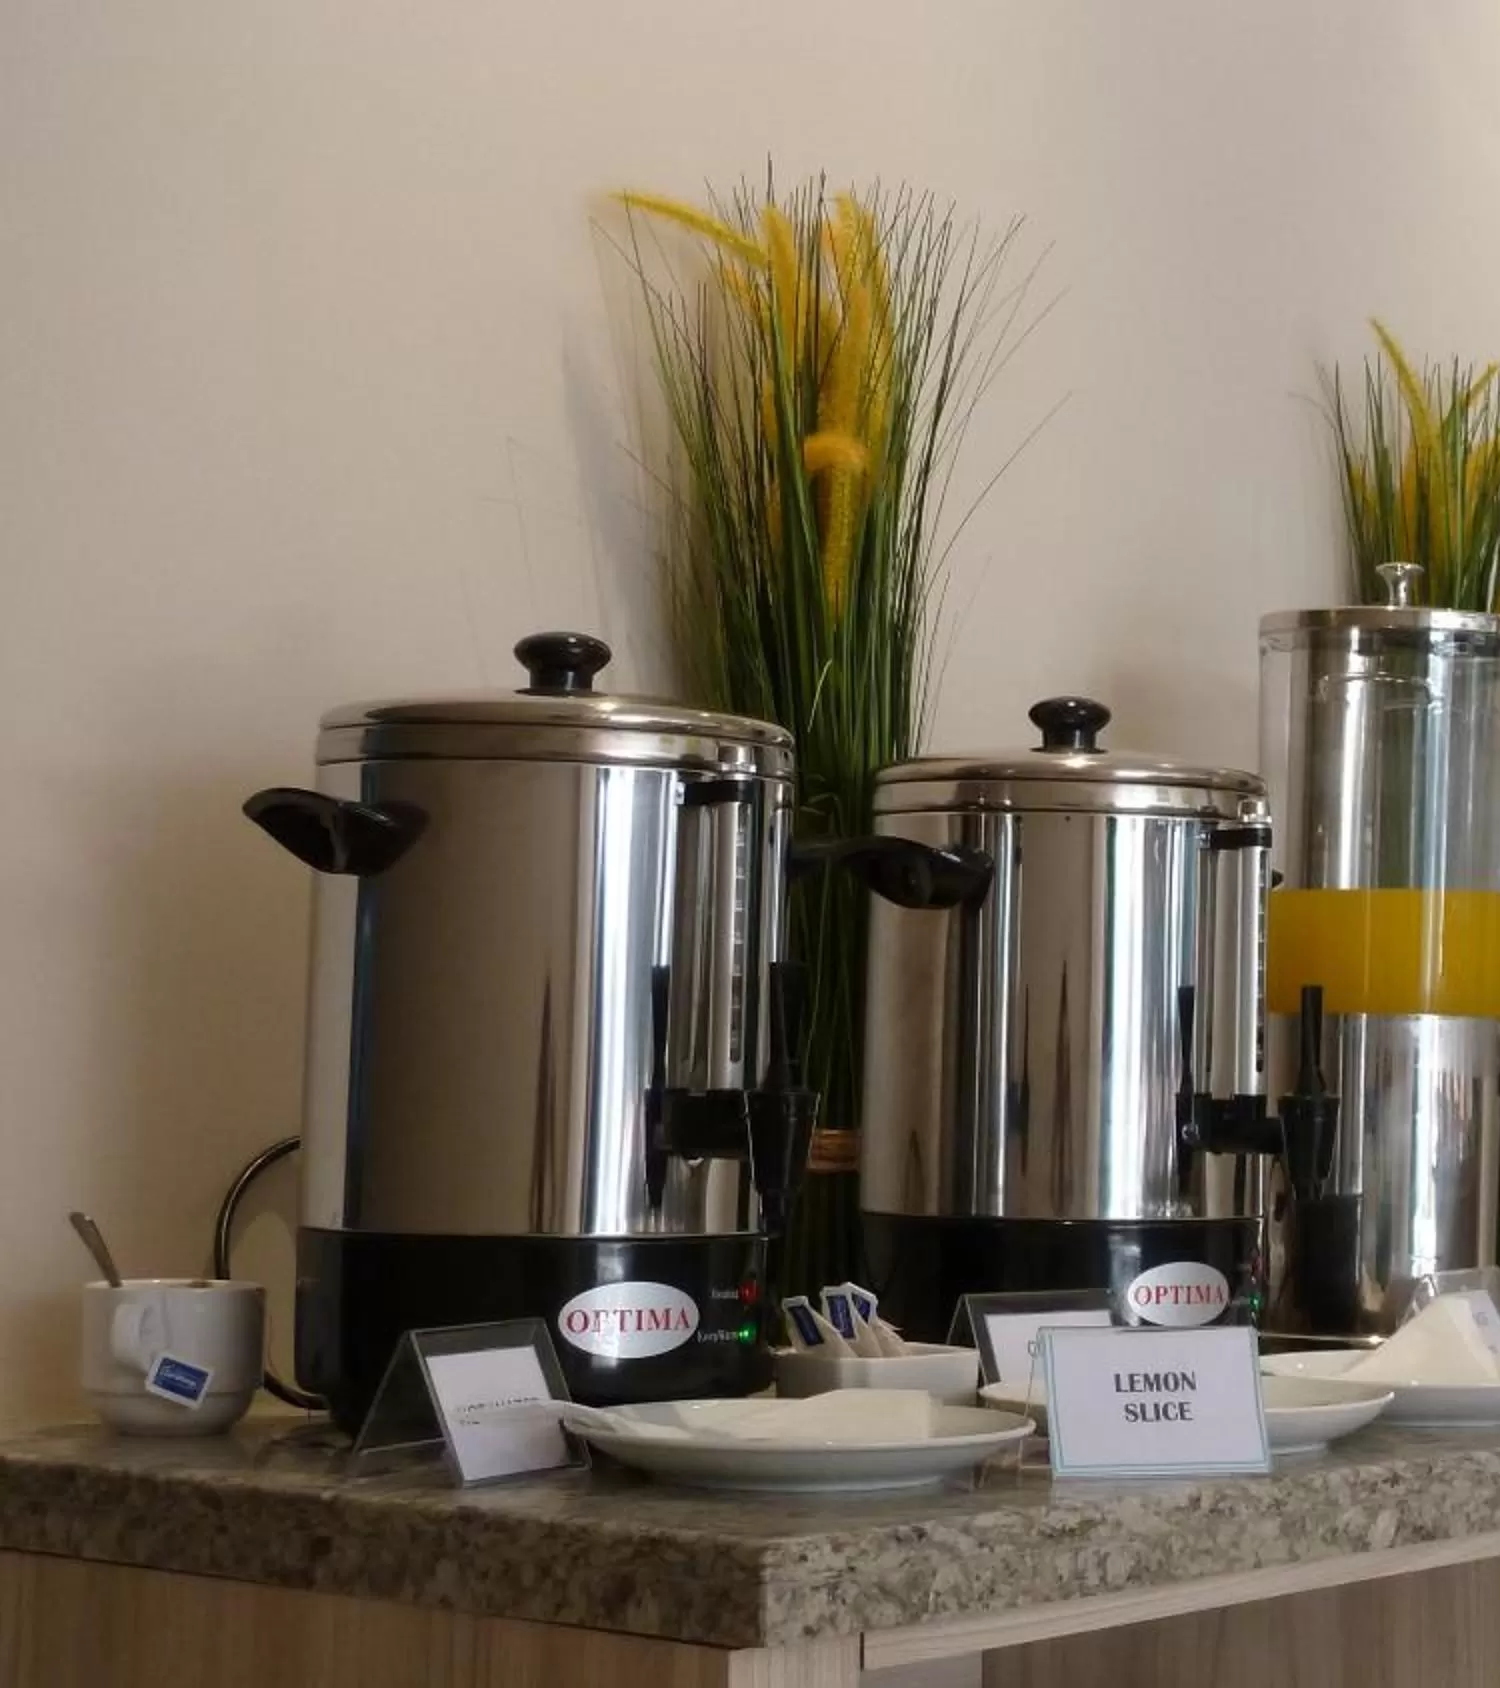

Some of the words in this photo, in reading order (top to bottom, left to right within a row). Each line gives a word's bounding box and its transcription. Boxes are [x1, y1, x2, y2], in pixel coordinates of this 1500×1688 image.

[1134, 1284, 1224, 1306] OPTIMA
[566, 1306, 691, 1333] OPTIMA
[1113, 1370, 1197, 1393] LEMON
[1124, 1401, 1195, 1423] SLICE
